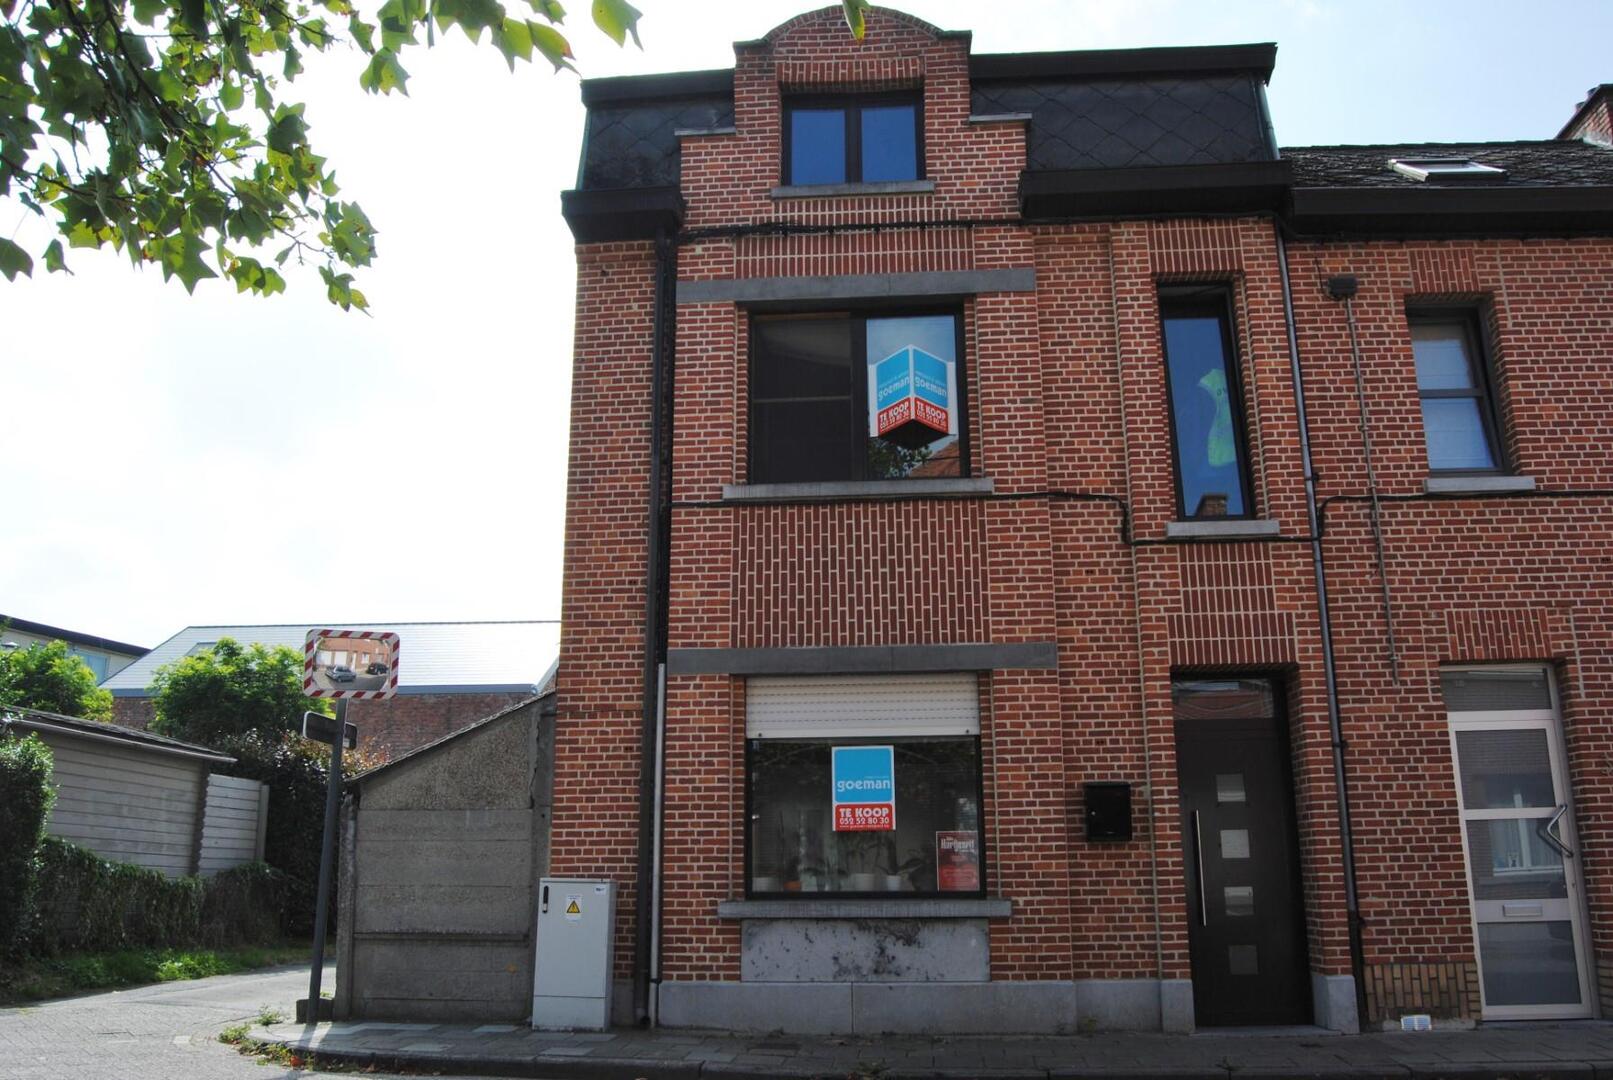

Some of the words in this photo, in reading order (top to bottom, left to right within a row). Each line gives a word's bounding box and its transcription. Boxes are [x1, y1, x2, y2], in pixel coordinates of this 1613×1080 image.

[879, 376, 910, 401] goeman
[915, 376, 947, 397] goeman
[889, 400, 909, 417] KOOP
[916, 400, 924, 412] TE
[926, 404, 946, 420] KOOP
[837, 779, 890, 792] goeman
[839, 808, 852, 817] TE
[855, 808, 889, 817] KOOP
[840, 817, 853, 825] 052
[856, 817, 866, 825] 52
[867, 817, 878, 825] 80
[880, 817, 890, 825] 30
